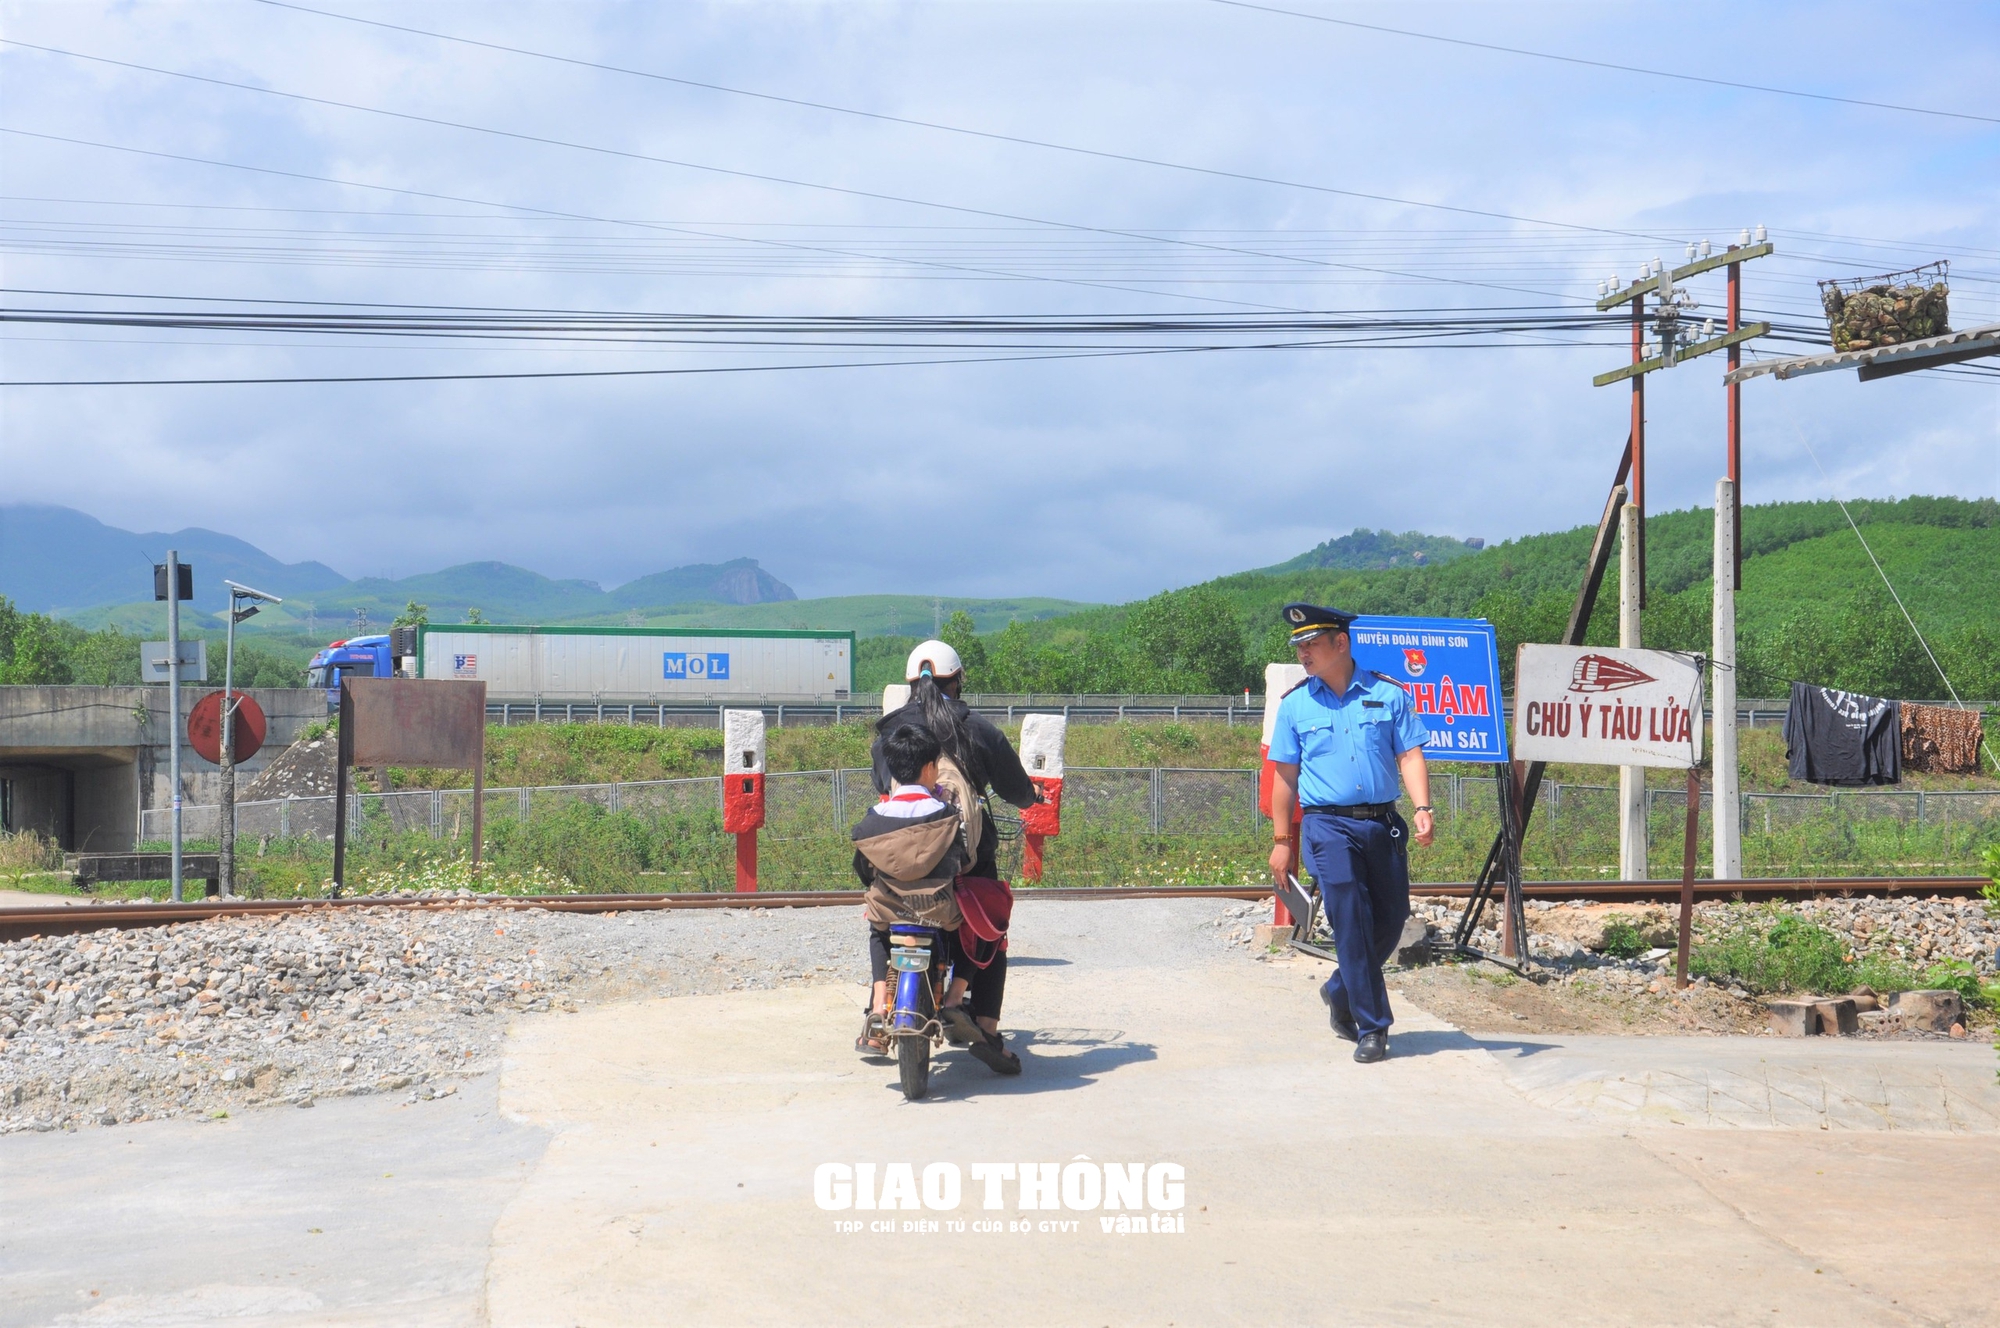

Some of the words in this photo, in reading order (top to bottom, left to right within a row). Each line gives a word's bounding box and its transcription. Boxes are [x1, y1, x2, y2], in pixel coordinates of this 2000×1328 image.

[1357, 632, 1390, 647] HUYỆN
[1392, 632, 1419, 646] ĐOÀN
[1422, 633, 1446, 647] BÌNH
[1448, 636, 1469, 648] SƠN
[666, 657, 726, 675] MOL
[1403, 675, 1490, 725] HẬM
[1526, 695, 1572, 738] CHÚ
[1579, 696, 1593, 738] Ý
[1599, 697, 1642, 741] TÀU
[1649, 695, 1692, 742] LỬA
[1423, 730, 1453, 748] AN
[1457, 728, 1488, 749] SÁT
